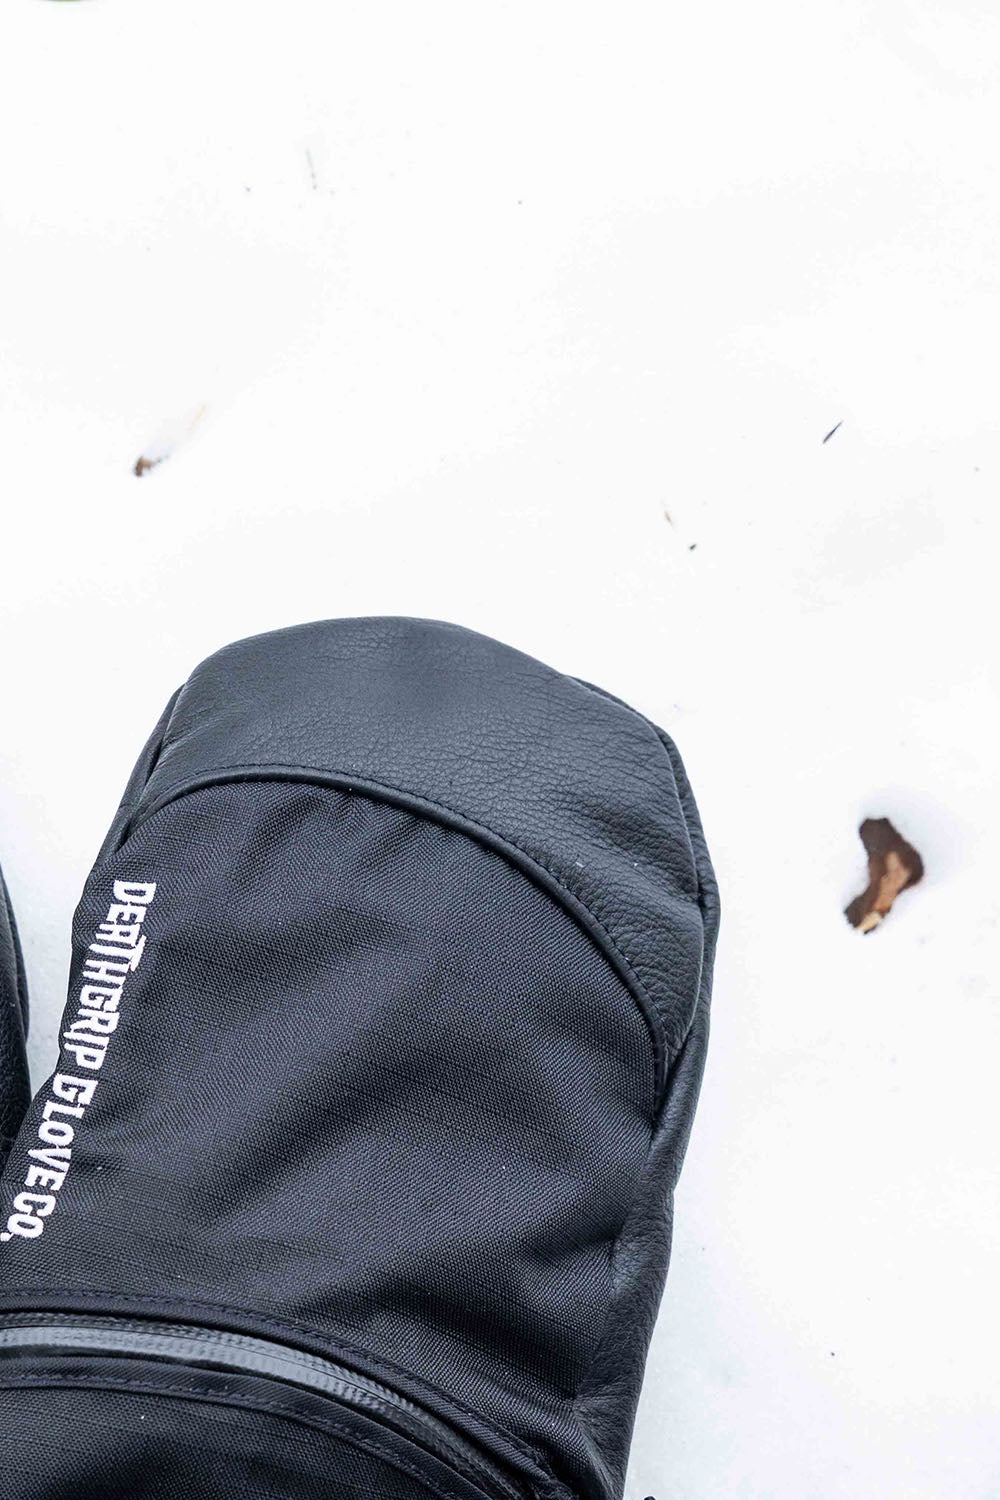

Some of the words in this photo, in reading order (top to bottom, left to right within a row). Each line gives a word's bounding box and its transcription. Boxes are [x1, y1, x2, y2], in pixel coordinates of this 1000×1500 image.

[63, 879, 157, 1071] DEATHGRIP
[23, 1072, 99, 1191] GLOVE
[0, 1191, 57, 1242] CO.
